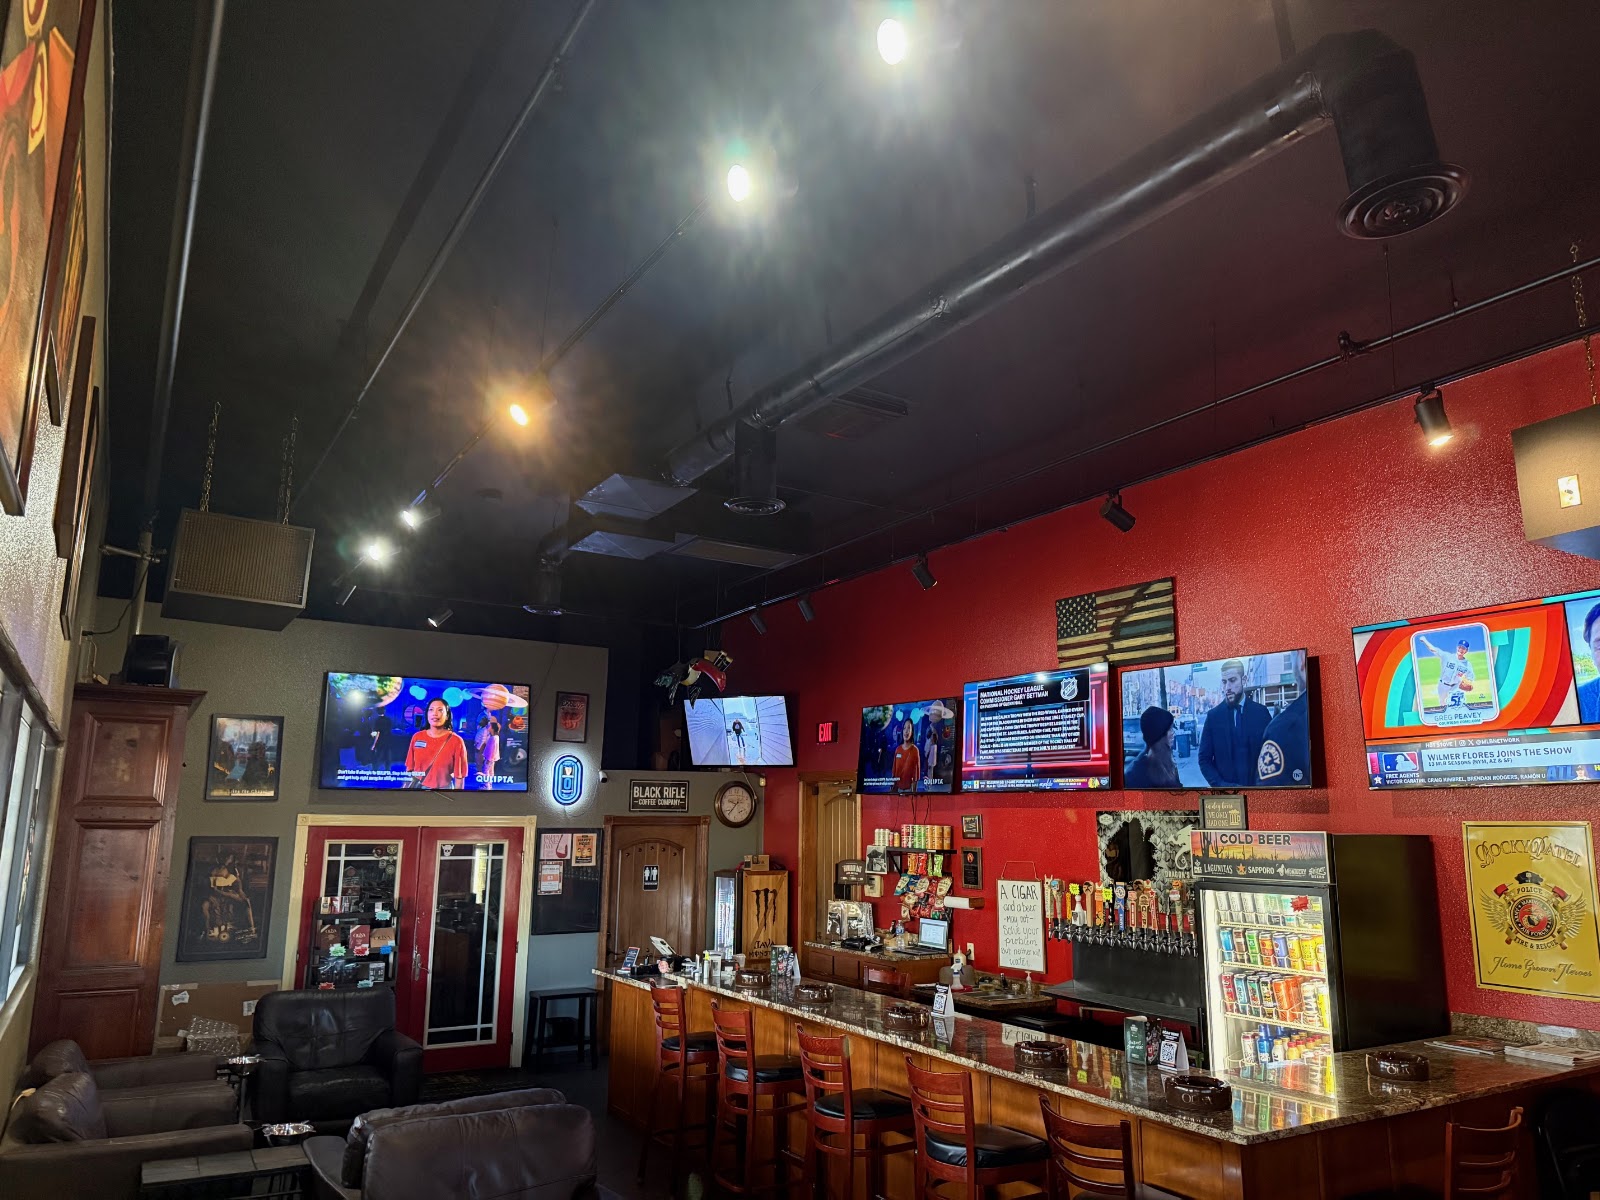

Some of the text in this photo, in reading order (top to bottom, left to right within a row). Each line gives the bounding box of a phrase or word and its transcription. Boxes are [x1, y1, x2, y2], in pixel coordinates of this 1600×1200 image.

[980, 690, 1003, 698] NATIONAL
[1004, 687, 1023, 695] HOCKEY
[980, 690, 1048, 704] COMMISSIONER GARY BETTMAN
[1434, 711, 1481, 722] GREG PEAVEY
[819, 722, 832, 742] EXIT
[1427, 746, 1573, 762] WILMER FLORES JOINS THE SHOW
[476, 775, 513, 783] QULIPTA
[1547, 765, 1575, 781] ATL
[633, 786, 686, 798] BLACK RIFLE
[1216, 811, 1229, 819] ONLY
[1220, 833, 1291, 846] COLD BEER
[1203, 863, 1233, 875] LAGUNITAS
[1247, 866, 1275, 875] SAPPORO
[1000, 884, 1039, 900] A CIGAR
[1517, 887, 1543, 895] POLICE
[1003, 900, 1015, 912] and
[1022, 926, 1040, 939] your
[754, 938, 776, 949] JAVA
[1514, 936, 1529, 947] FIRE
[1535, 938, 1559, 950] RESCUE
[1488, 956, 1593, 982] Home Grown Heroes
